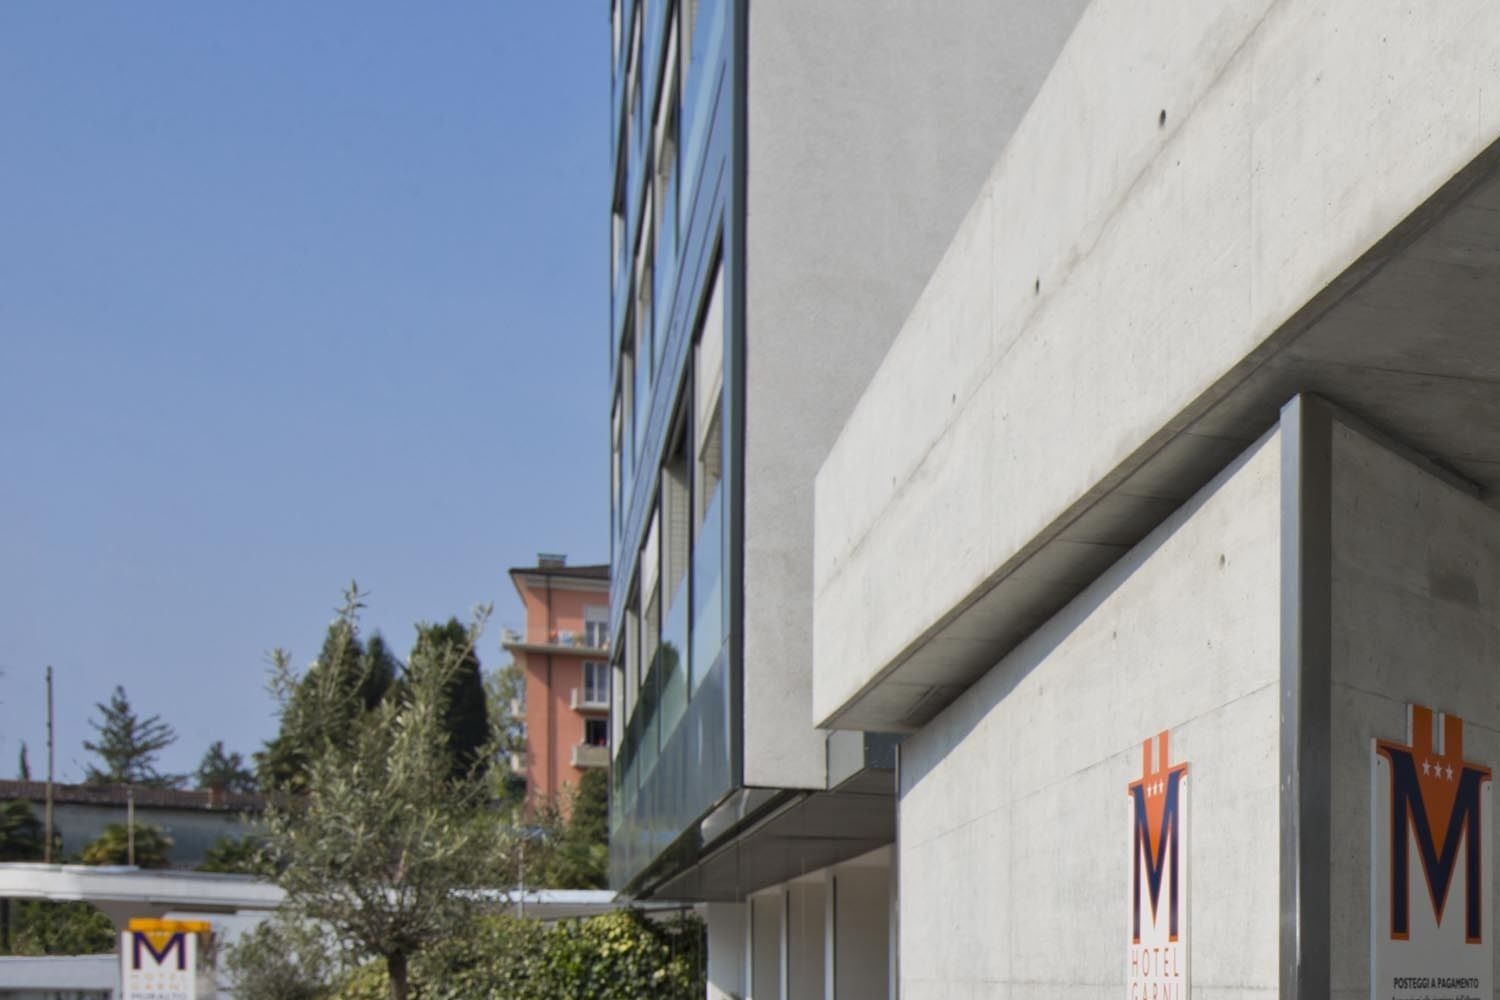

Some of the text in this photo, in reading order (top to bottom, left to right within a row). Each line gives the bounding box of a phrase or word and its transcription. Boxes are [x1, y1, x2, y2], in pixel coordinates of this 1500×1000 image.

[1128, 761, 1188, 944] M
[1376, 739, 1492, 944] M
[132, 931, 186, 970] M
[1131, 948, 1180, 977] HOTEL
[1393, 977, 1479, 989] POSTEGGI A PAGAMENTO
